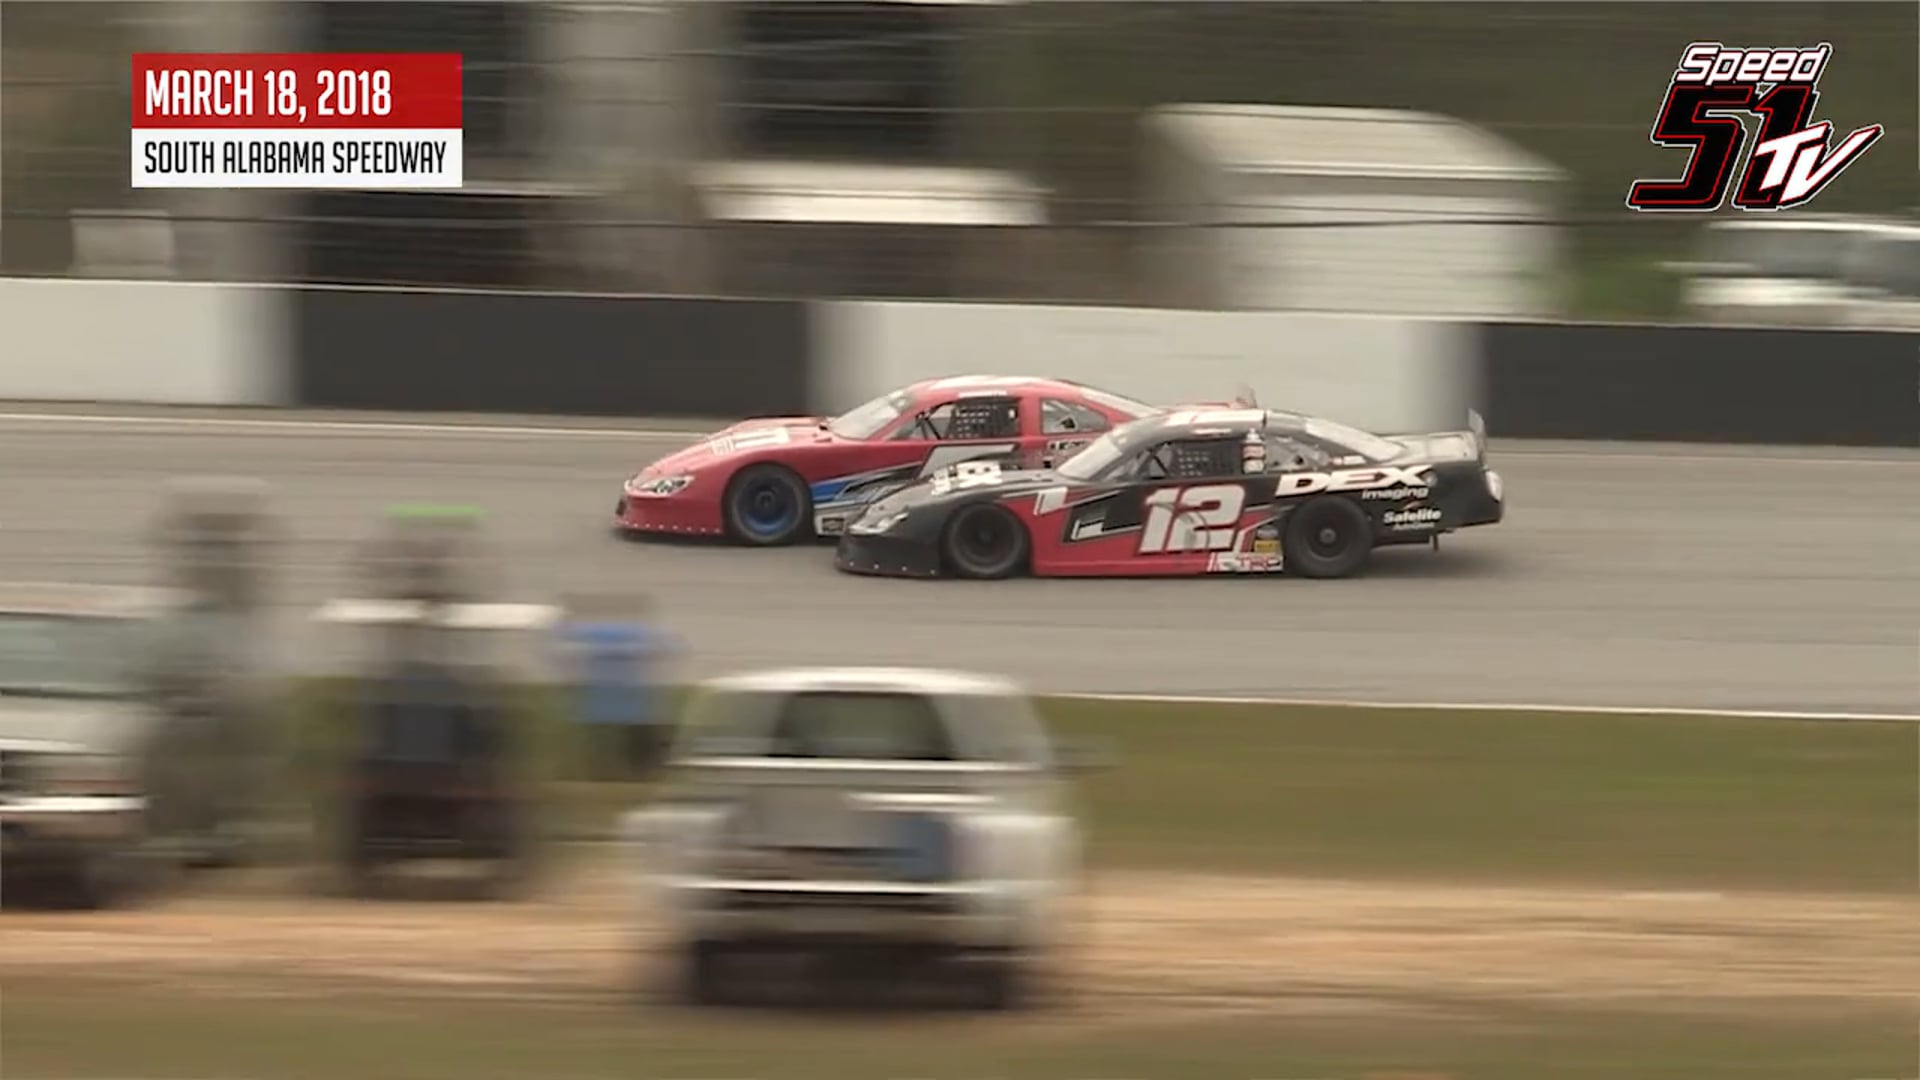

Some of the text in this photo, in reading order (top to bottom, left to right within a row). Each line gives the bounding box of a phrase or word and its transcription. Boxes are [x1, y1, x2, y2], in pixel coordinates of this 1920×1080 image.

[1275, 464, 1433, 497] DEX
[1138, 484, 1246, 553] 12
[1383, 509, 1442, 524] Safelite
